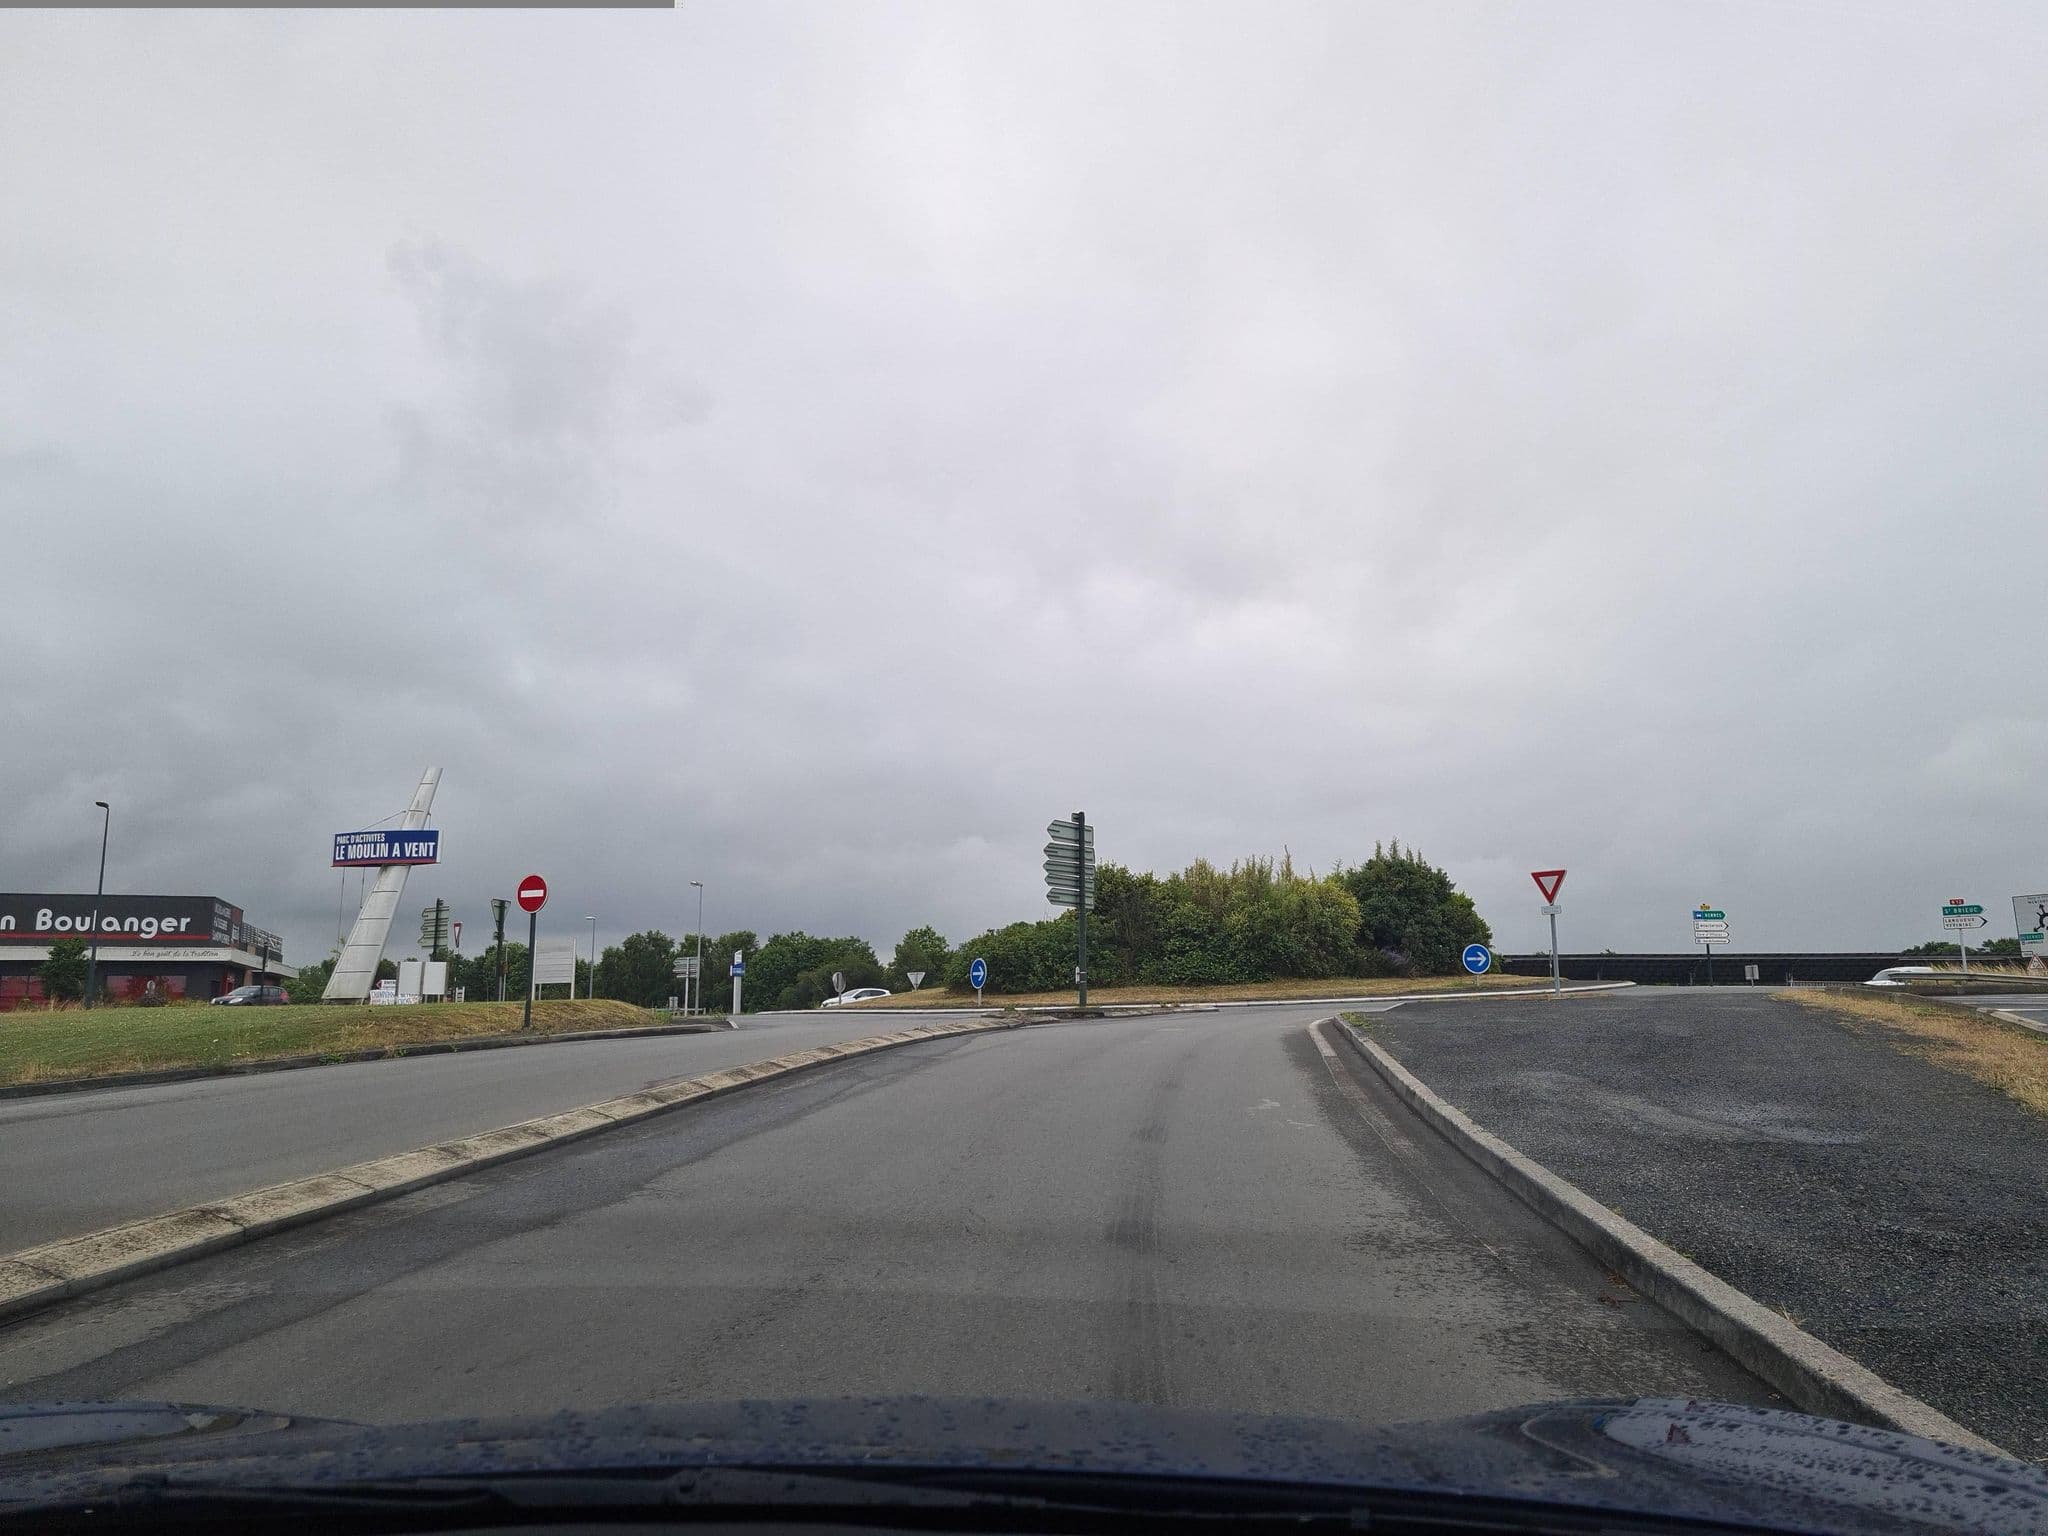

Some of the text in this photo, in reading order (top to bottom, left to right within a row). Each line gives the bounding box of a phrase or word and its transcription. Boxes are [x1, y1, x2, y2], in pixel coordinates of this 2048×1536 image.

[336, 836, 350, 845] PARC
[335, 842, 436, 860] LE MOULIN A VENT
[35, 908, 191, 938] Boulanger
